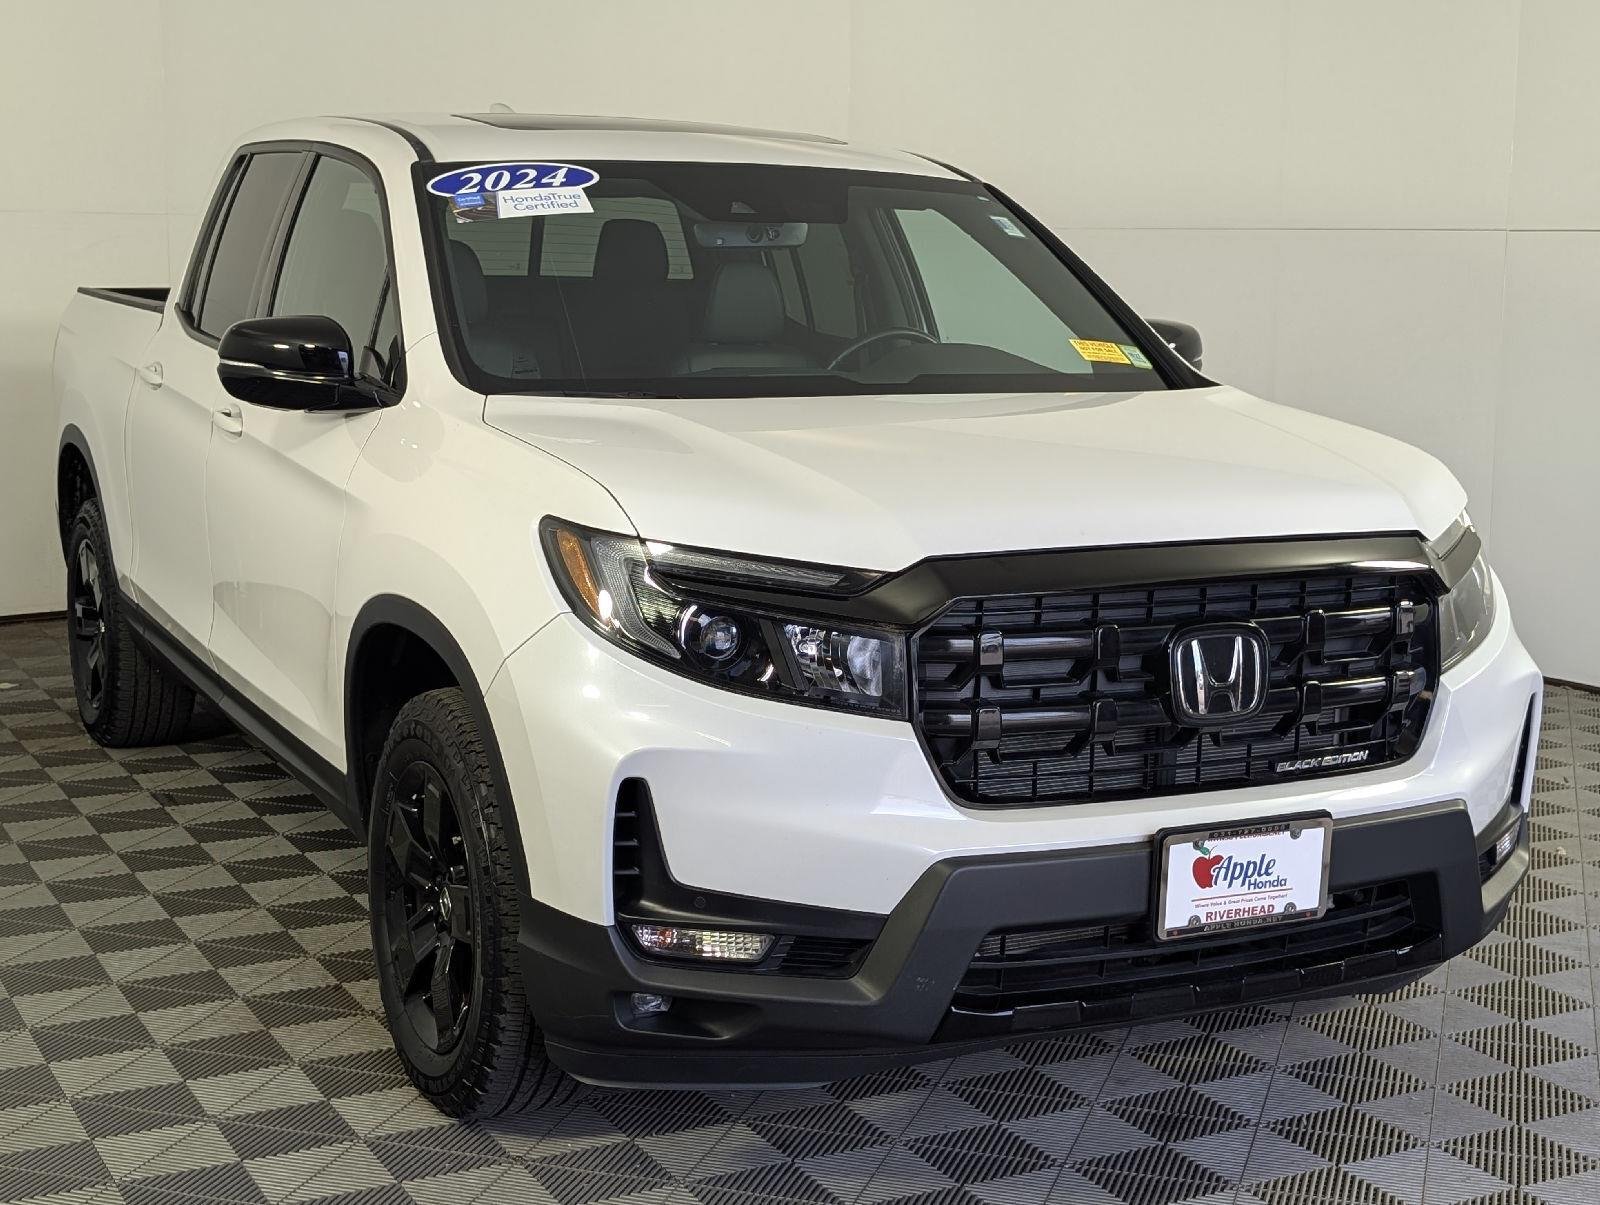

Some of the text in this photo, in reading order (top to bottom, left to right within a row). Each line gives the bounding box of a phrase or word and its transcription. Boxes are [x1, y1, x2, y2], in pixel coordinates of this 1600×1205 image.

[456, 167, 568, 194] 2024
[502, 192, 581, 204] HondaTrue
[513, 200, 579, 211] Certified
[1276, 750, 1369, 773] BLACK EDITION
[1212, 853, 1276, 889] Apple
[1248, 875, 1287, 890] Honda
[1205, 904, 1275, 921] RIVERHEAD
